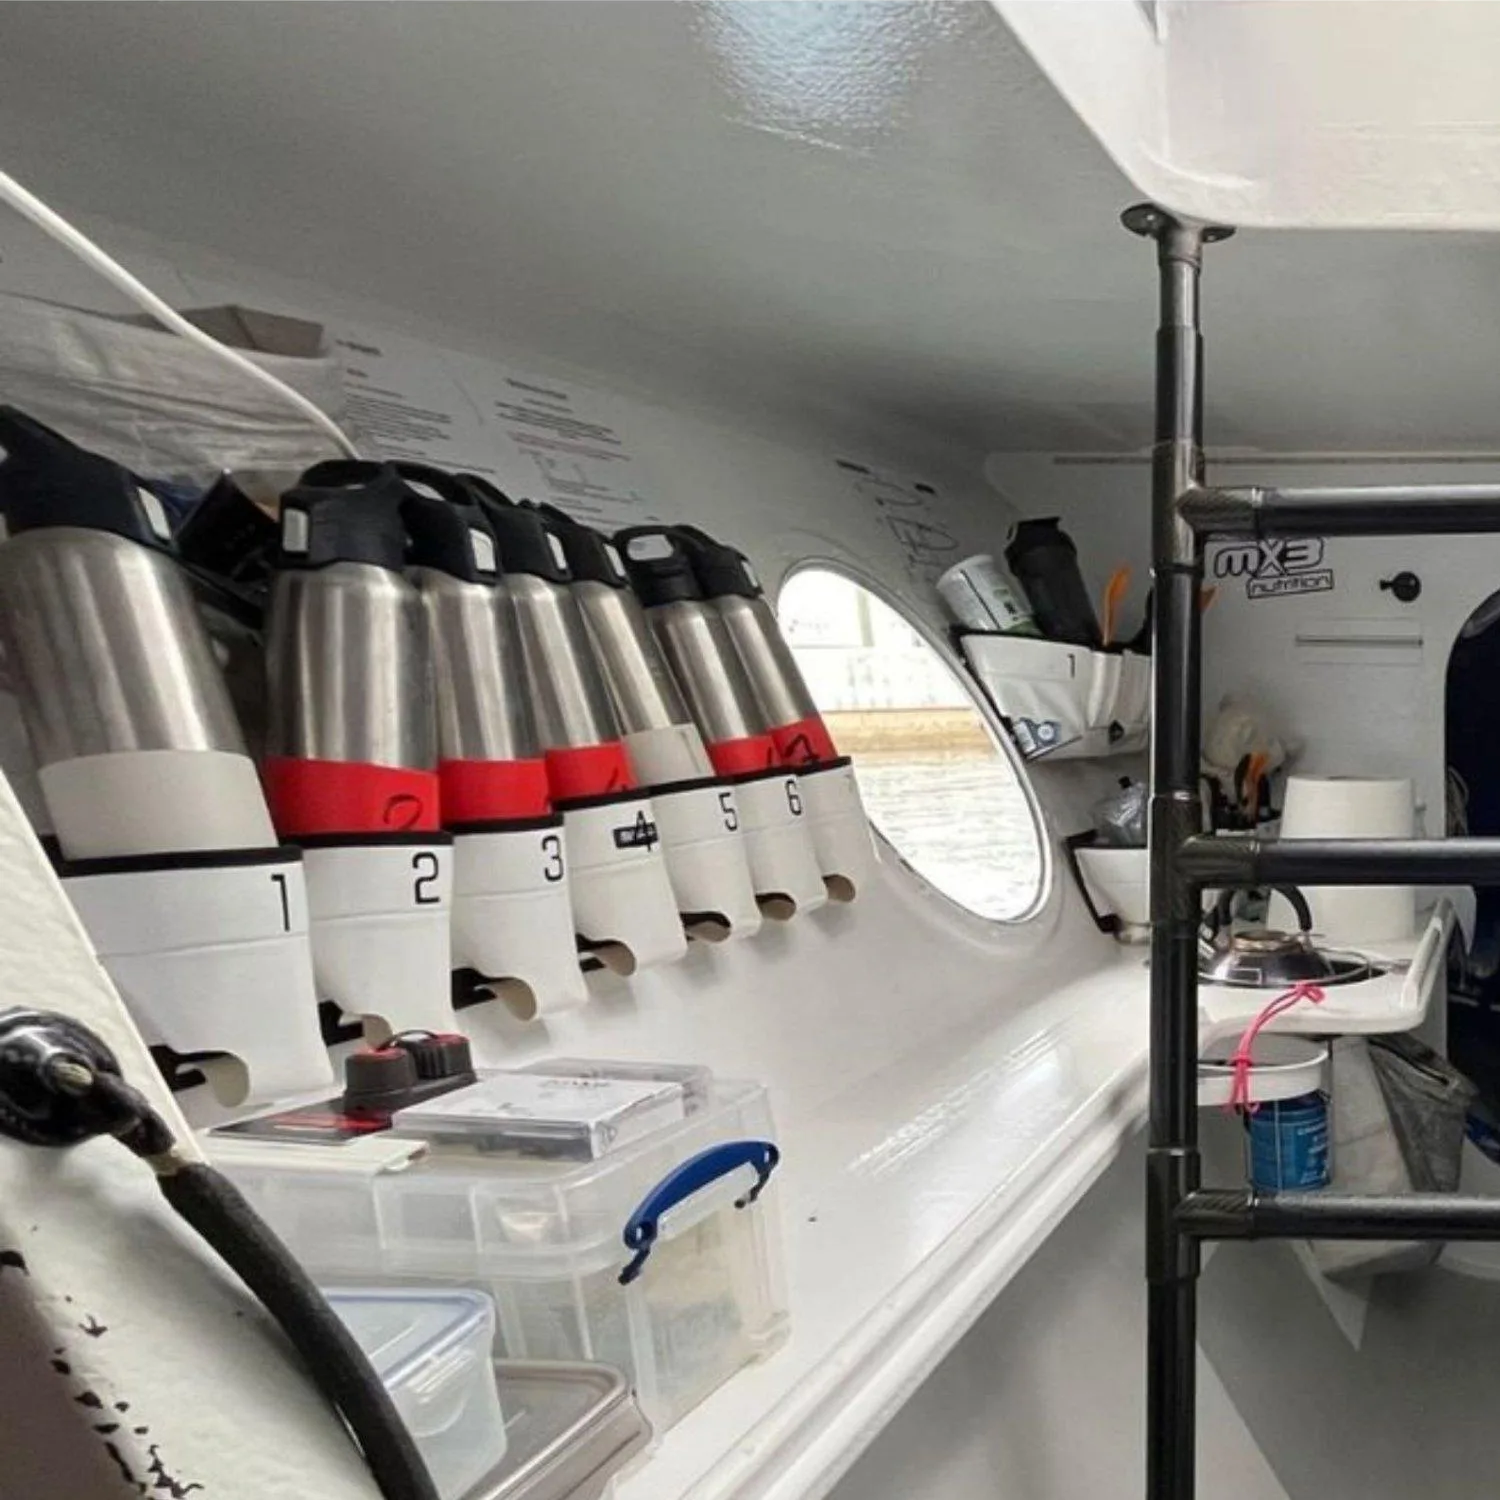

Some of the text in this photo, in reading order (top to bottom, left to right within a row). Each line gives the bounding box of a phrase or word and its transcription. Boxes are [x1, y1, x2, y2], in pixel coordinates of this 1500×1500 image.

[717, 791, 738, 832] 5
[784, 778, 803, 816] 6
[411, 851, 442, 905] 2
[541, 834, 564, 882] 3
[270, 873, 291, 933] 1
